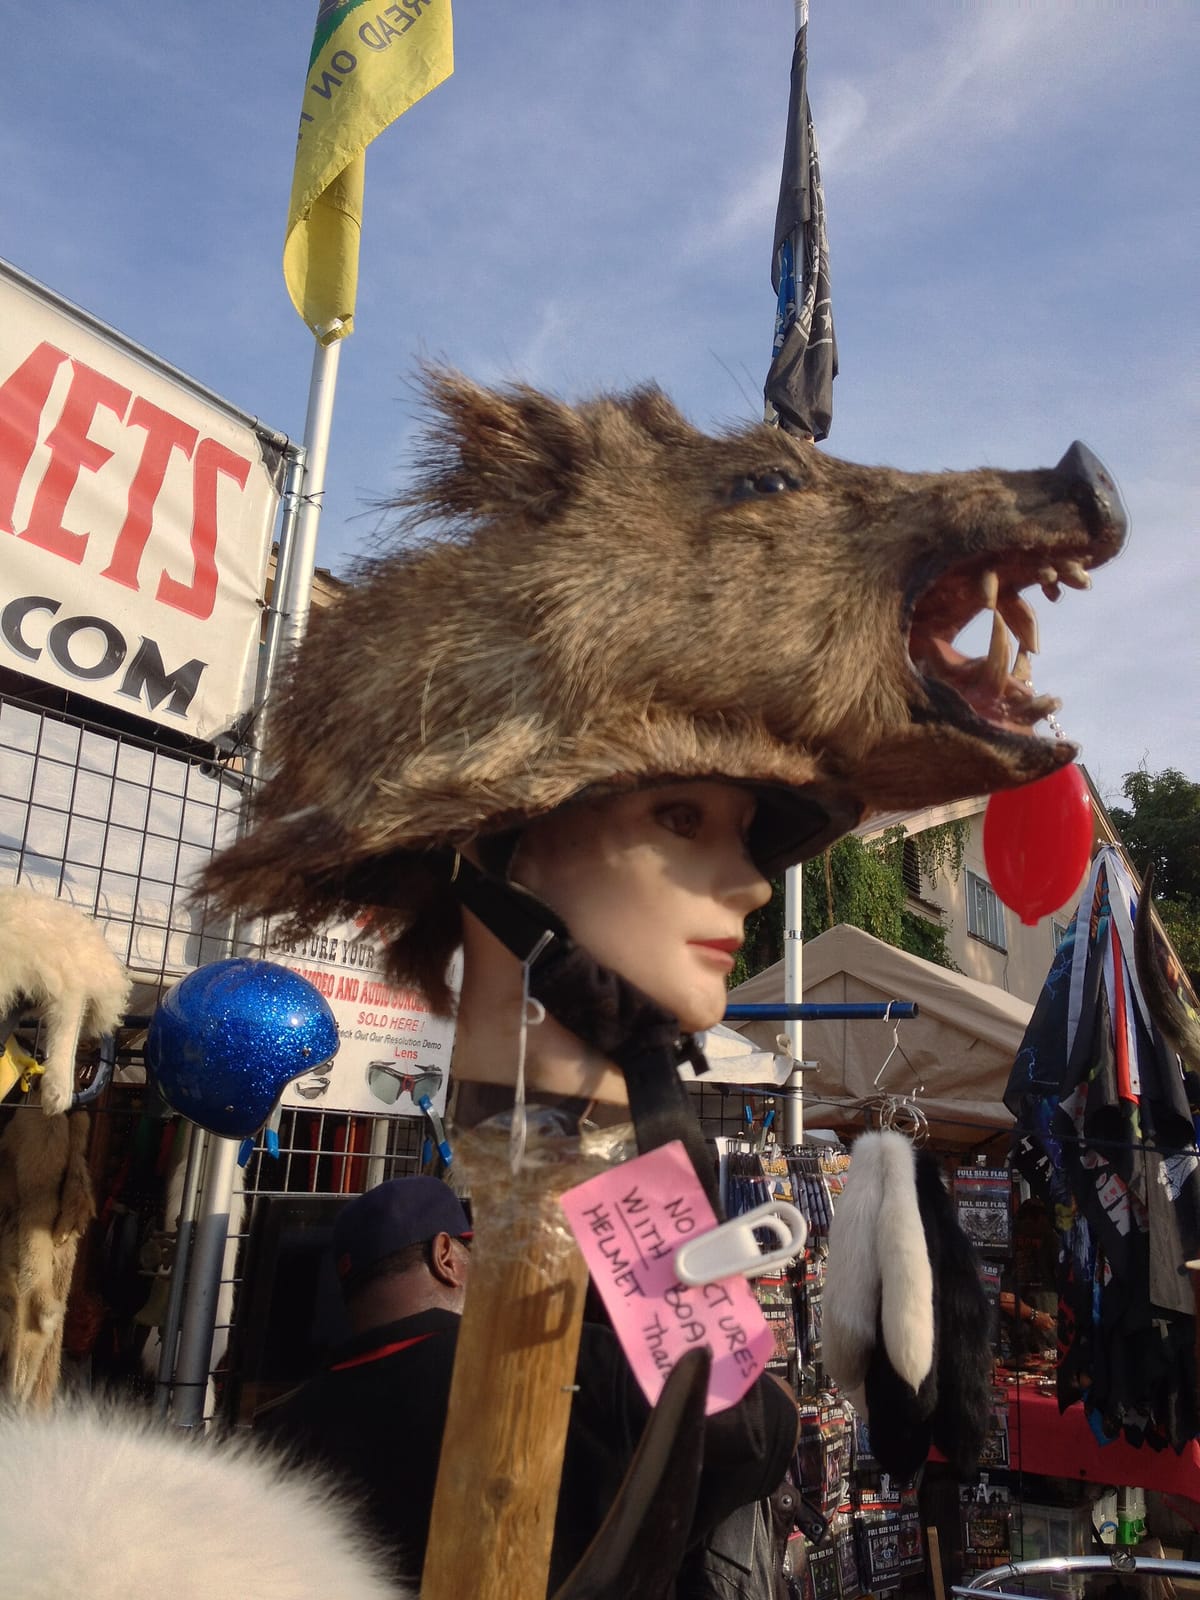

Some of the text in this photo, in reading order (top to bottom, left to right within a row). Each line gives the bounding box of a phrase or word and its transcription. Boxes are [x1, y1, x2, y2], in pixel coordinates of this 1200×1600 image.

[342, 938, 375, 969] YOUR
[335, 976, 360, 1003] AND
[357, 1011, 388, 1029] SOLD
[390, 1017, 420, 1033] HERE
[355, 1030, 369, 1040] Out
[369, 1032, 384, 1042] Our
[384, 1034, 422, 1047] Resolution
[422, 1039, 442, 1050] Demo
[394, 1047, 418, 1059] Lens
[957, 1169, 972, 1177] FULL
[623, 1186, 672, 1260] WITH
[664, 1197, 756, 1378] NO CTURES
